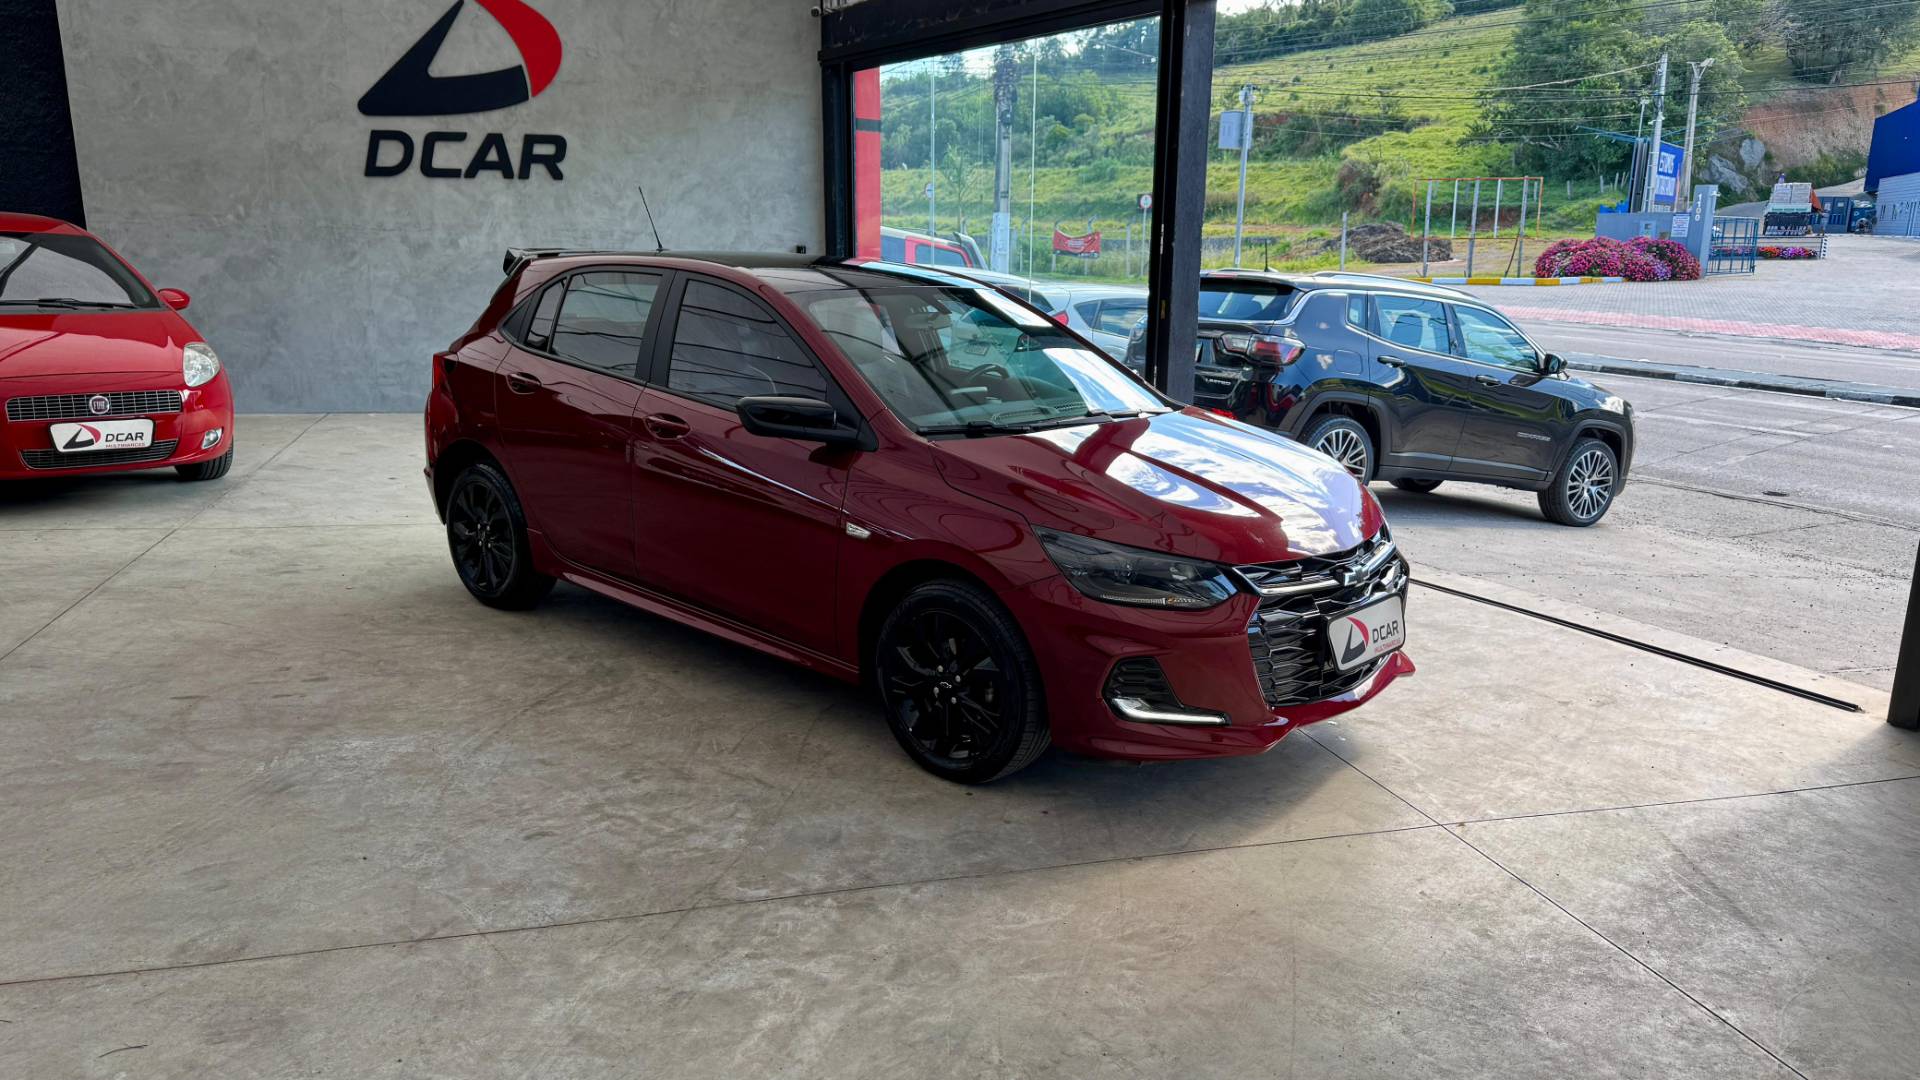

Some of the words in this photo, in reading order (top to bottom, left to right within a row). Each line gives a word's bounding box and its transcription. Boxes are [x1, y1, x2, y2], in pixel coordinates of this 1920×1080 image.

[364, 129, 568, 181] DCAR
[1694, 193, 1702, 222] 1100
[105, 432, 144, 443] DCAR
[1372, 620, 1399, 644] DCAR
